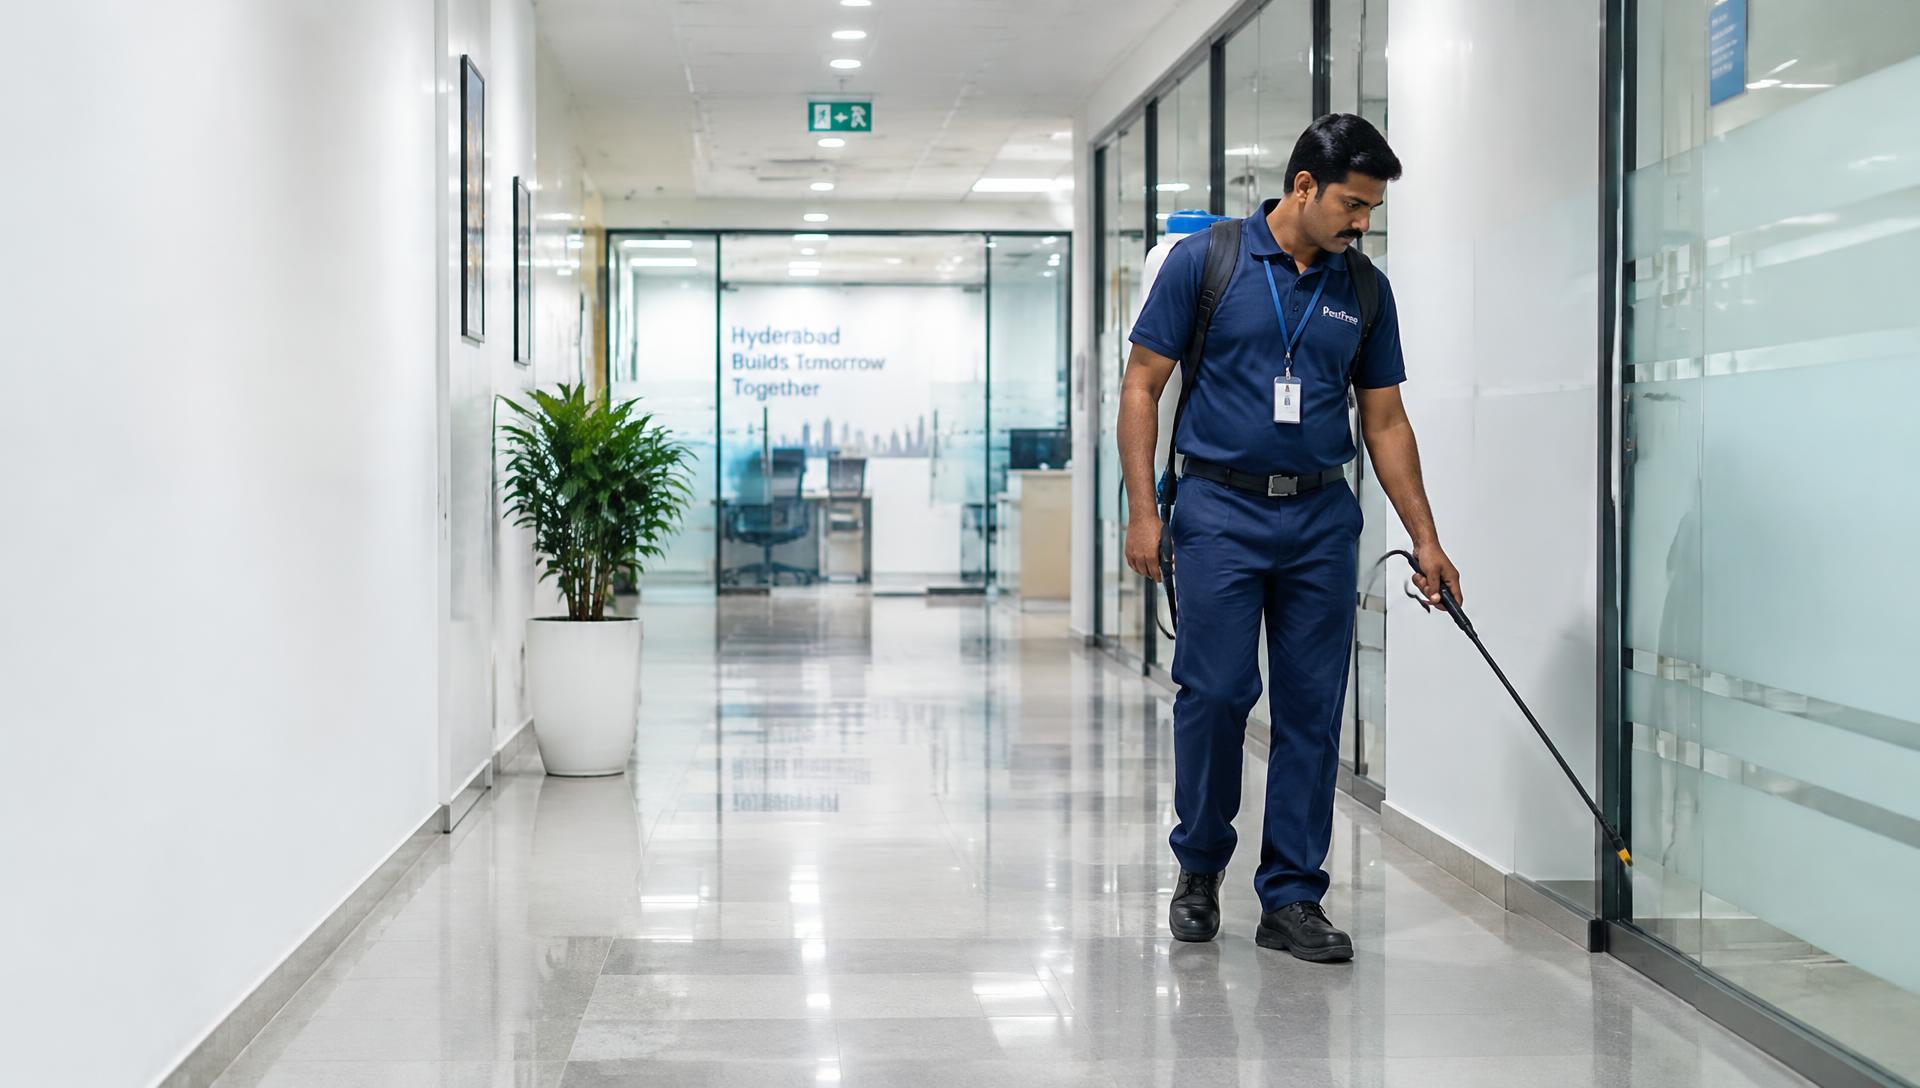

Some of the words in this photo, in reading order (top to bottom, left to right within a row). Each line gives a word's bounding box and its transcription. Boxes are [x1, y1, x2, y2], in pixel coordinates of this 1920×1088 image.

[732, 326, 840, 350] Hyderabad
[732, 353, 789, 370] Builds
[732, 378, 819, 401] Together
